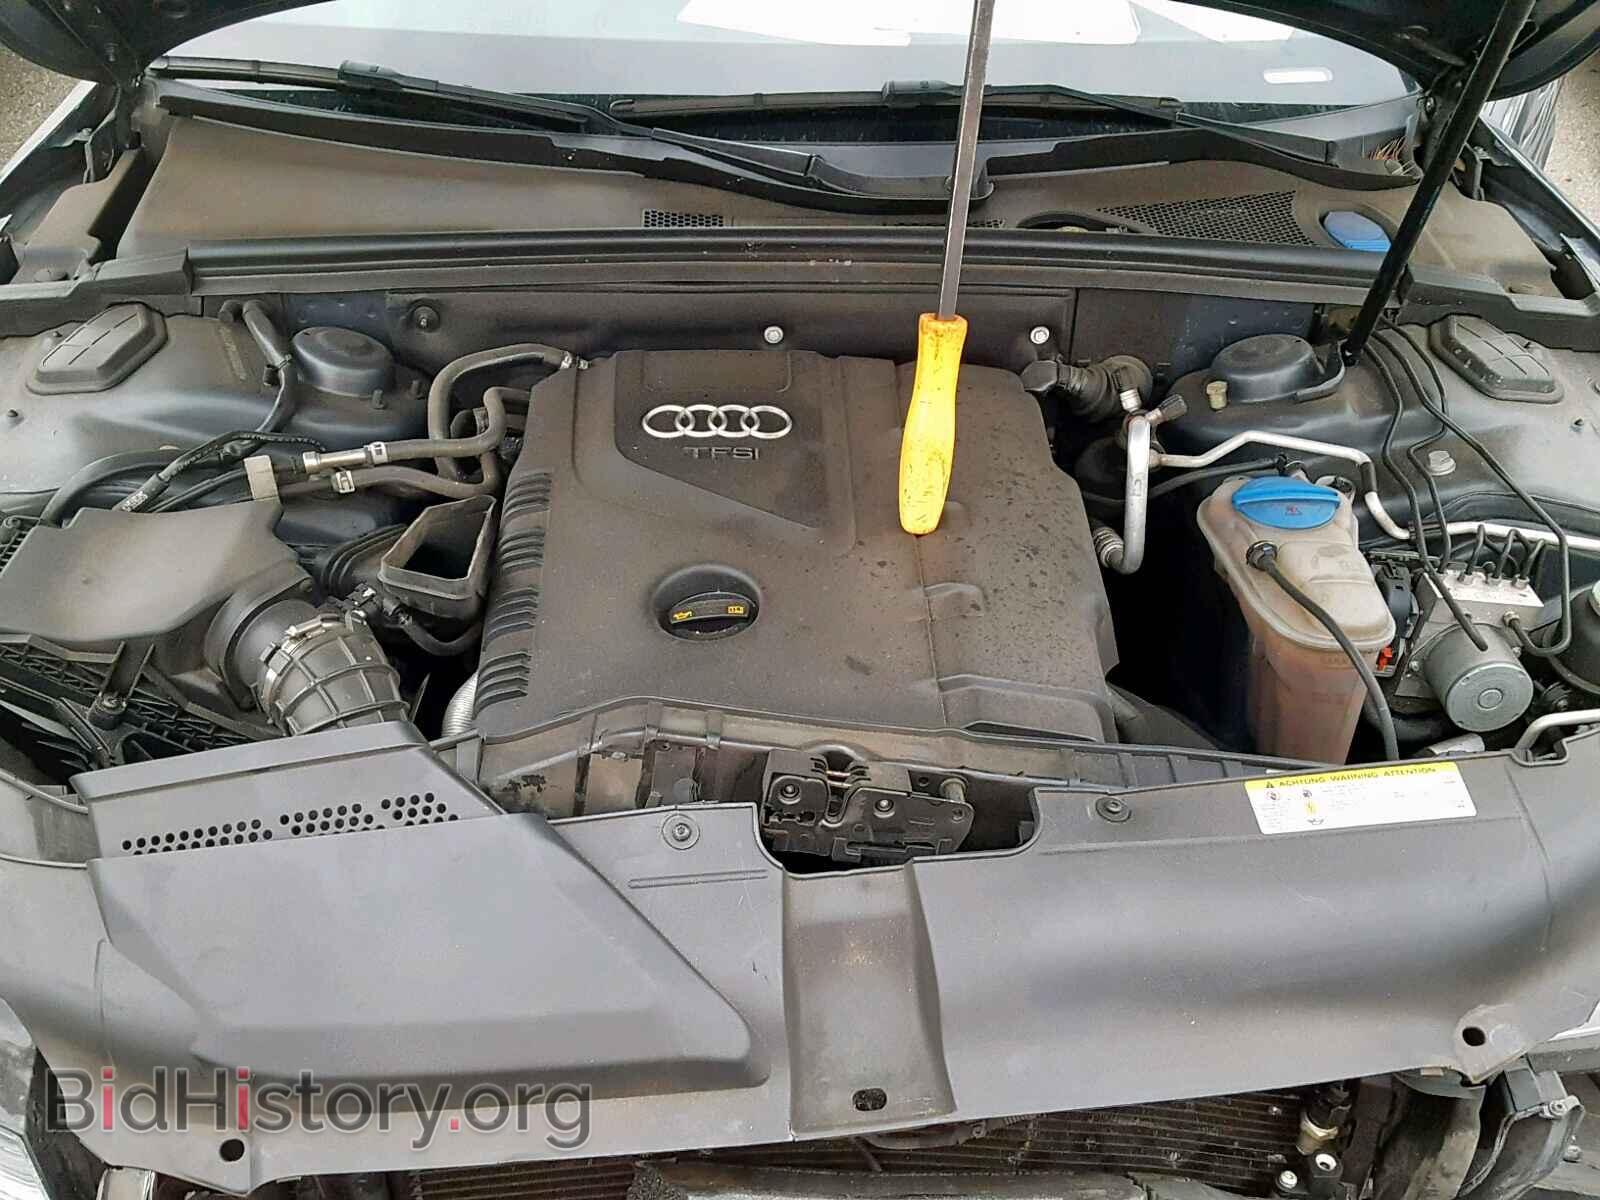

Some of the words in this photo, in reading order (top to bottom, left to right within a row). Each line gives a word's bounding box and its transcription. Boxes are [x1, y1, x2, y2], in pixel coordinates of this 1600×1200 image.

[683, 446, 760, 461] TFSI
[1279, 776, 1326, 788] ACHTUNG
[1330, 771, 1379, 782] WARNING
[1383, 767, 1437, 777] ATTENTION
